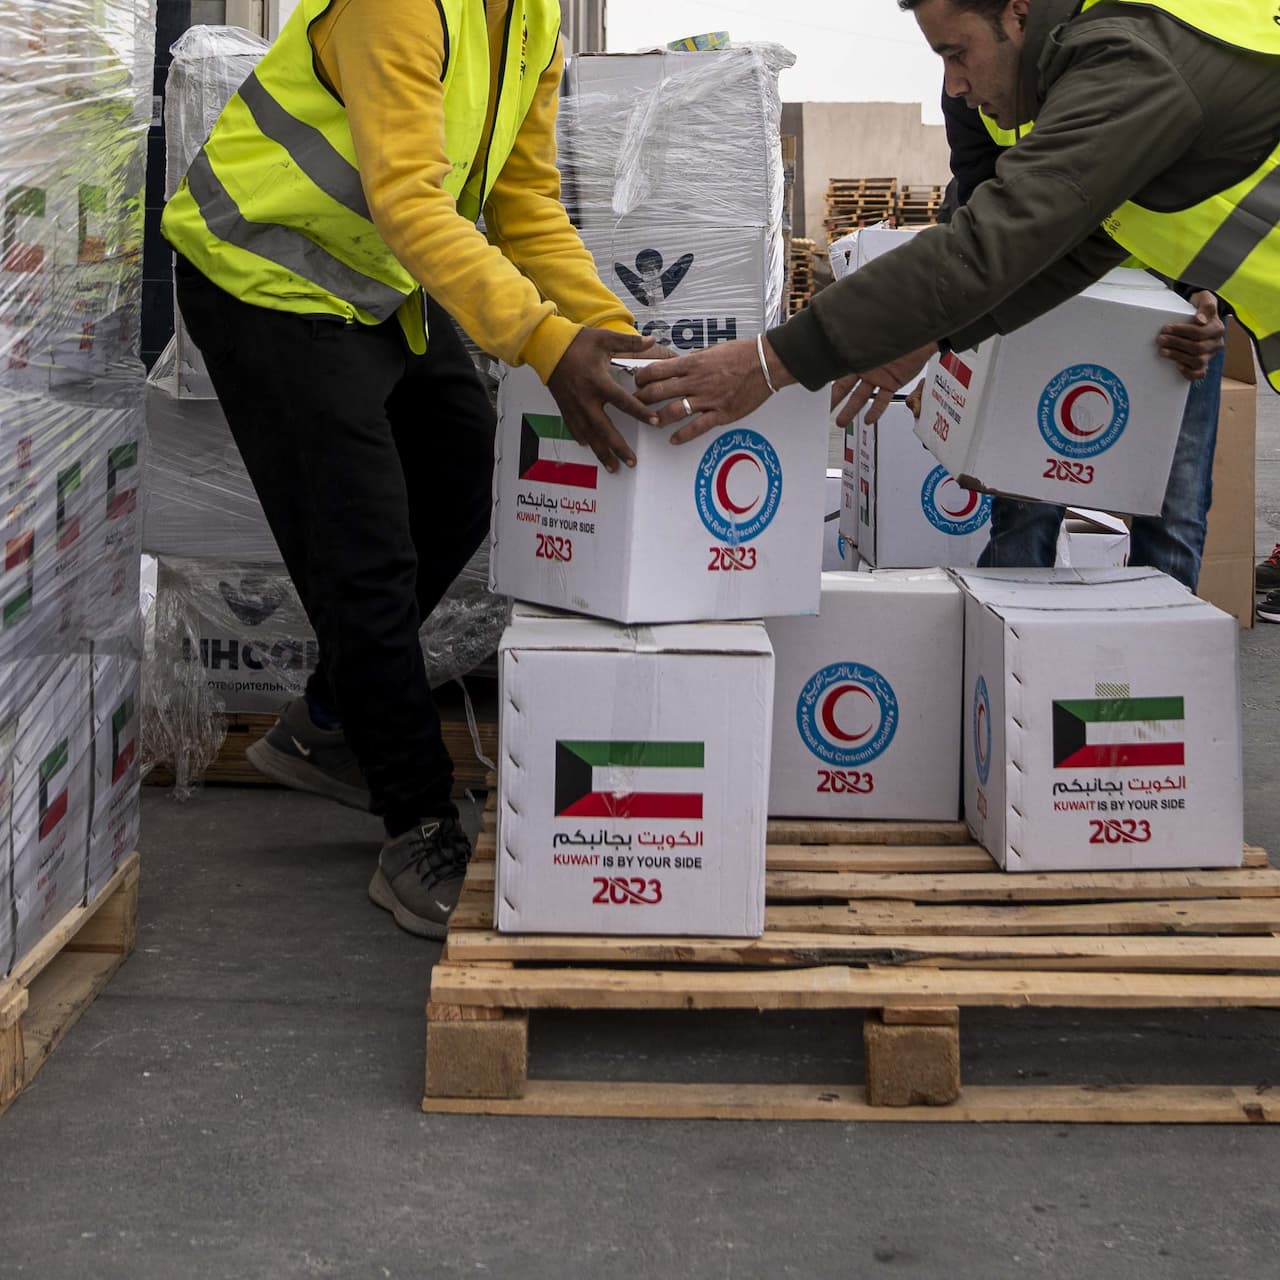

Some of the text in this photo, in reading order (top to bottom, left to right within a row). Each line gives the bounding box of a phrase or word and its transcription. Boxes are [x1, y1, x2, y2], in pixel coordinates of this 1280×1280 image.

[1043, 458, 1094, 484] 2023
[517, 492, 596, 514] الكويت بجانبكم
[536, 533, 572, 562] 2023
[707, 546, 757, 572] 2023
[816, 769, 874, 795] 2023
[1053, 776, 1186, 797] الكويت بجانبكم
[1054, 799, 1185, 811] KUWAIT IS BY YOUR SIDE
[553, 829, 703, 851] الكويت بجانبكم
[1089, 819, 1151, 845] 2023
[554, 854, 702, 869] KUWAIT IS BY YOUR SIDE
[592, 876, 663, 906] 2023
